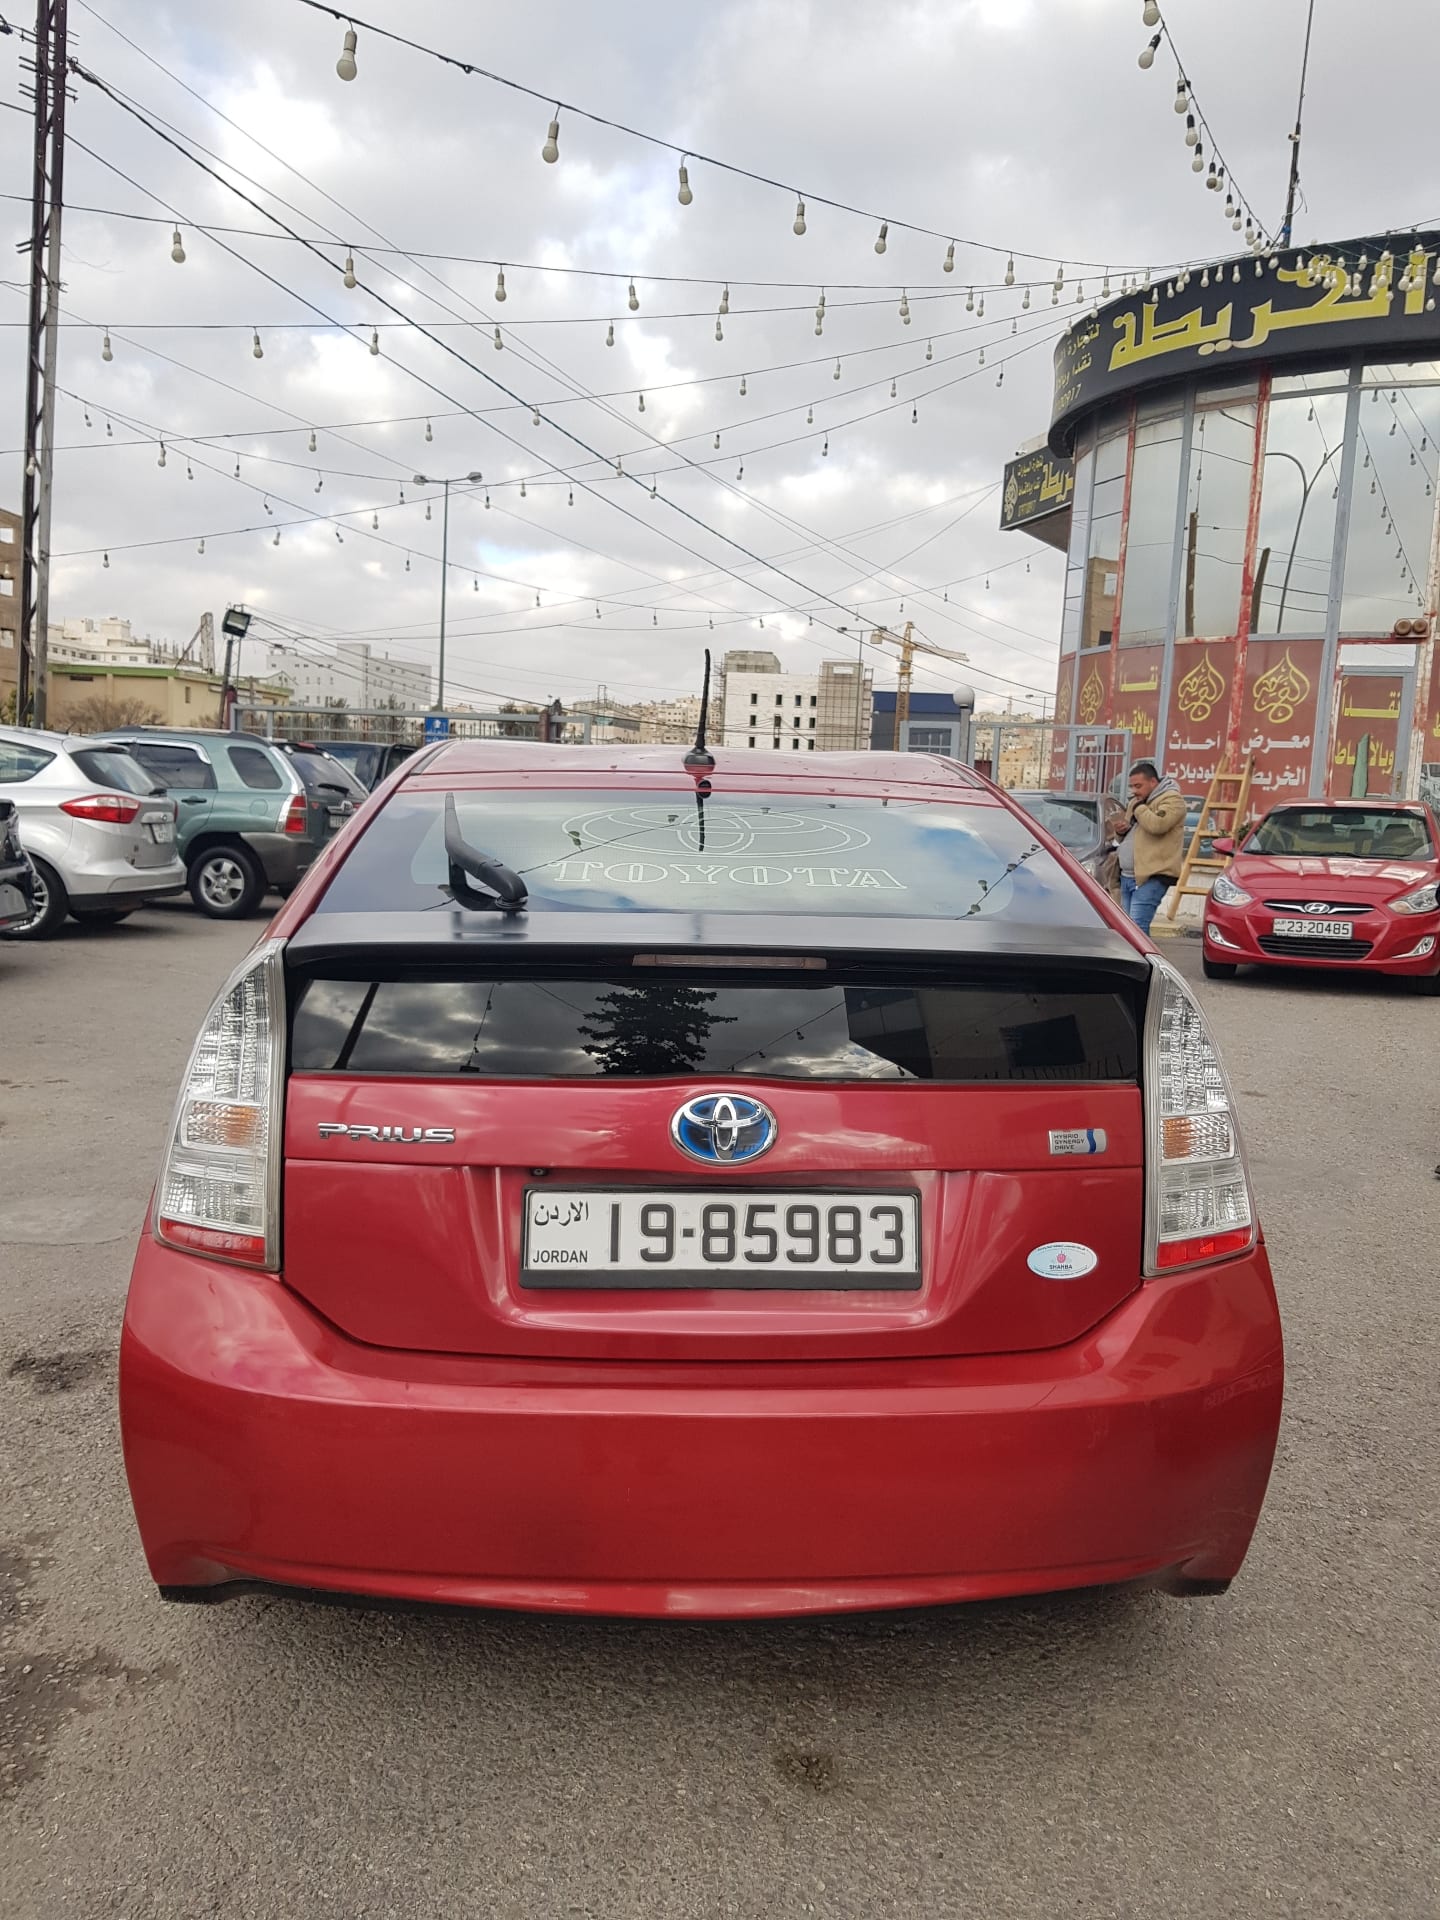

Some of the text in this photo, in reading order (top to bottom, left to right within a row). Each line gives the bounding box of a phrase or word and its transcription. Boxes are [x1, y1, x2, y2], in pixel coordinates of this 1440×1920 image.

[1241, 728, 1311, 755] معرض
[1241, 764, 1307, 791] الخريط
[548, 860, 908, 890] TOYOTA
[1287, 921, 1350, 935] 23-20485
[318, 1122, 456, 1143] PRIUS
[609, 1202, 904, 1264] 19-85983
[532, 1248, 589, 1264] JORDAN
